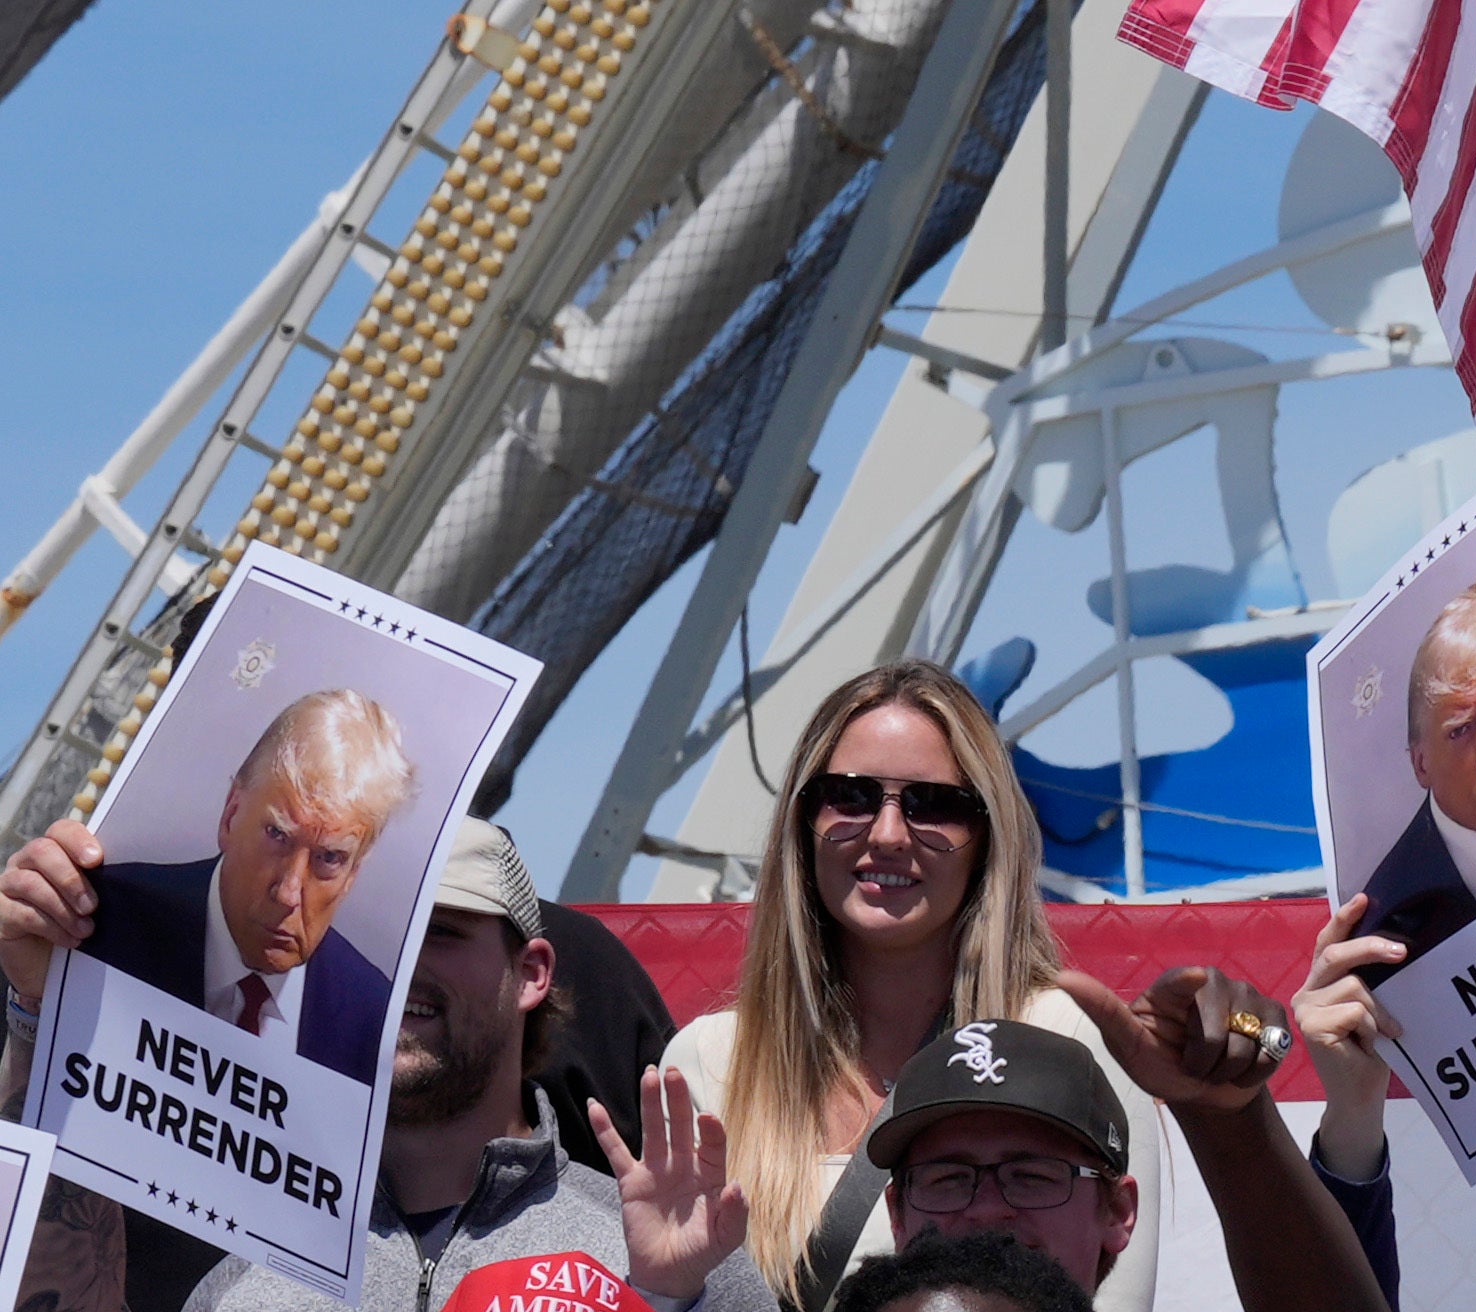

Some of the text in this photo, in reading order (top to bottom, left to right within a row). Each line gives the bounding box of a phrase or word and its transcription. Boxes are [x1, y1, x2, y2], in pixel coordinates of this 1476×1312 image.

[135, 1017, 289, 1127] NEVER
[948, 1022, 1007, 1084] Sox
[60, 1052, 344, 1218] SURRENDER
[525, 1259, 622, 1312] SAVE
